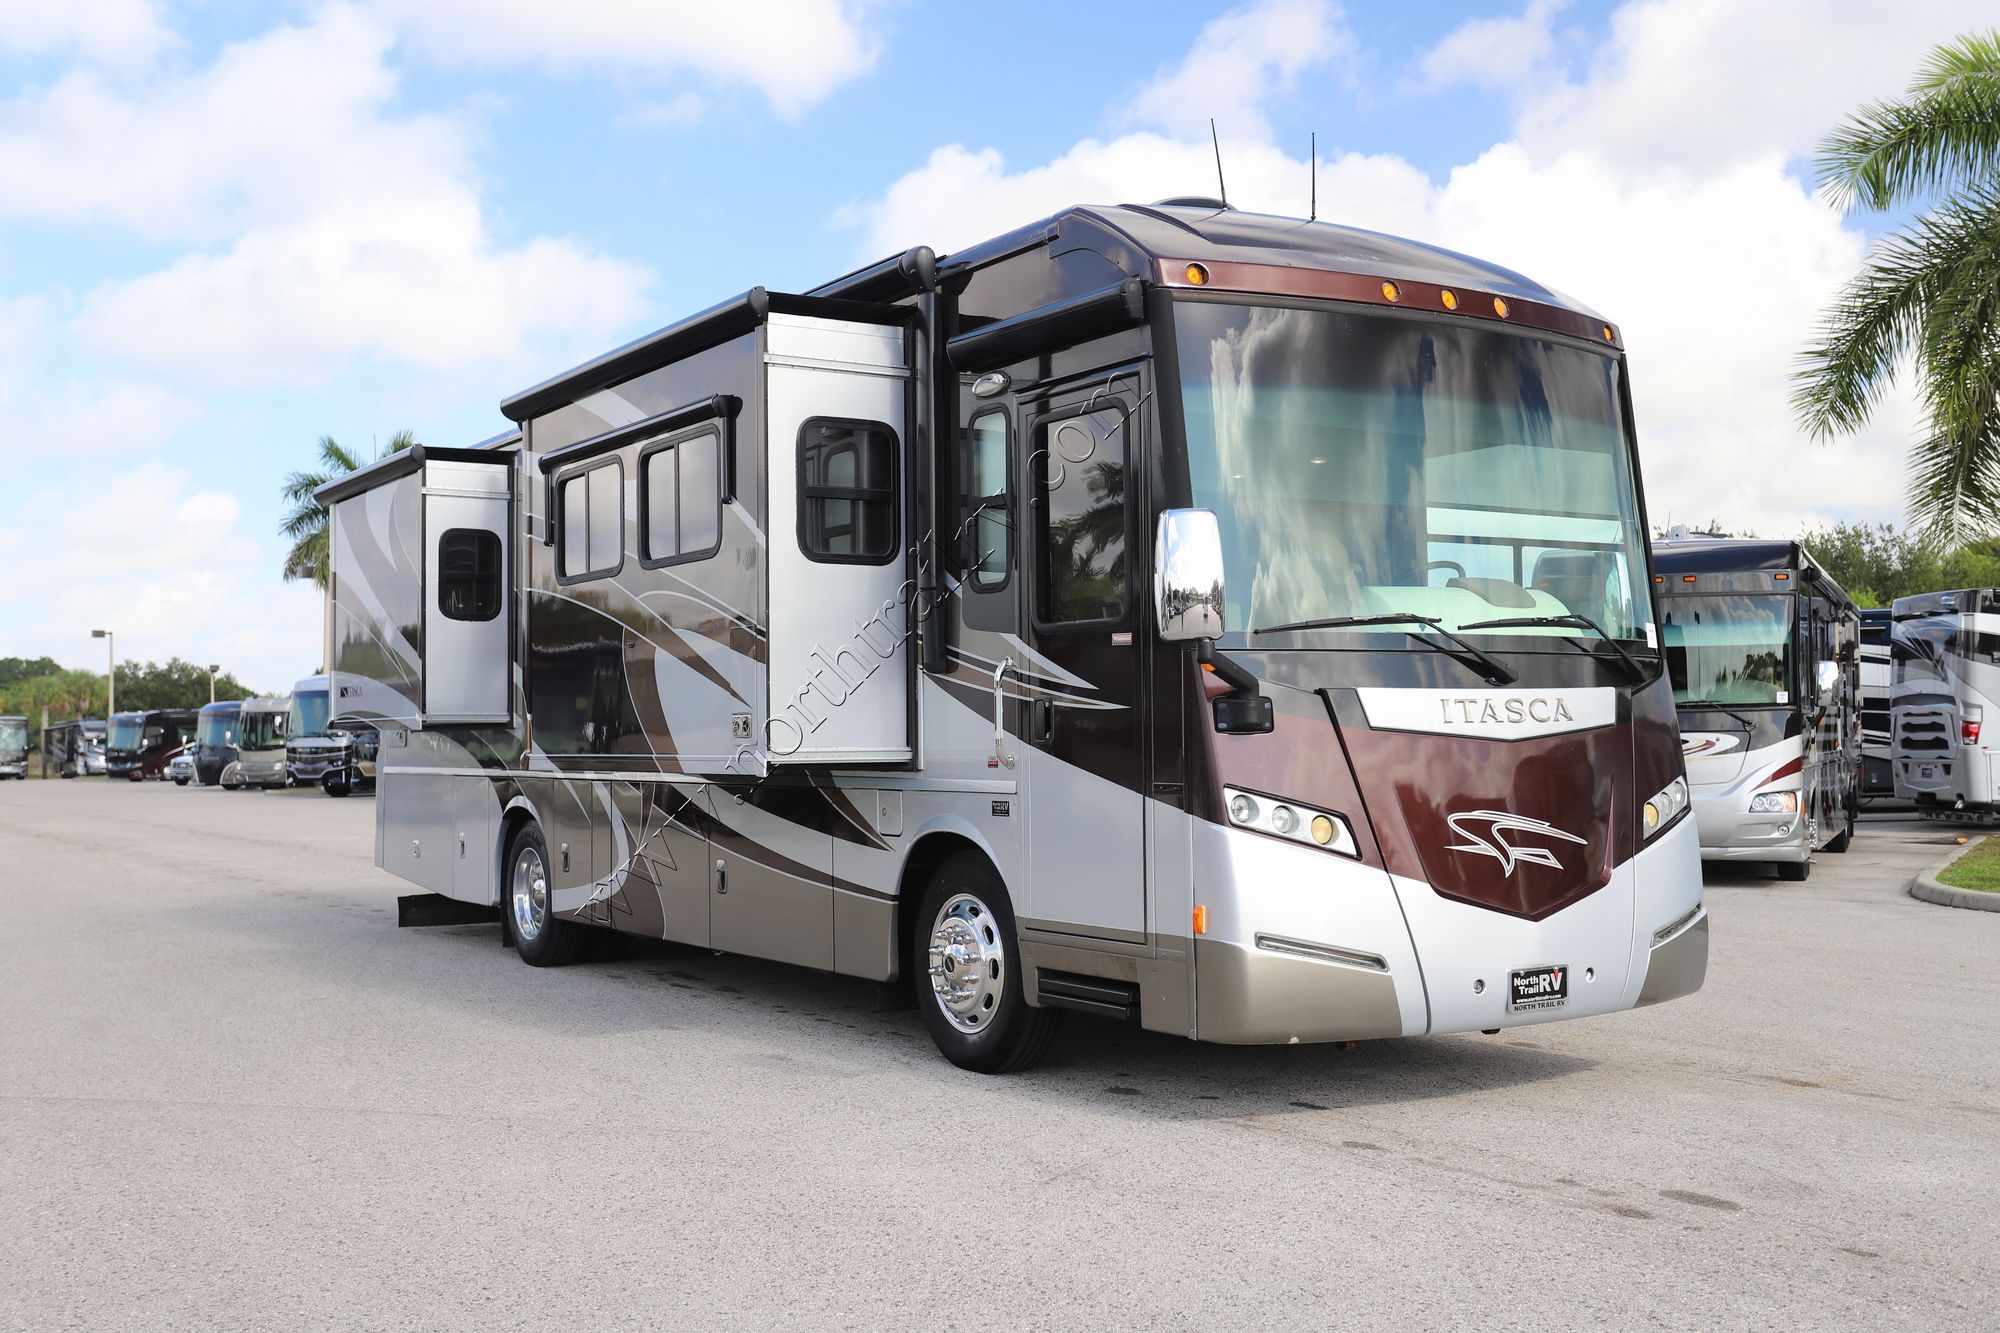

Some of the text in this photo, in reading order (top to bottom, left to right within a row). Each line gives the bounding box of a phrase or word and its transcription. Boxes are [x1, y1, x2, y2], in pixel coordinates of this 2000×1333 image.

[1440, 698, 1574, 724] ITASCA
[1513, 972, 1562, 992] North RV
[1519, 985, 1538, 994] Trail
[1514, 1003, 1536, 1011] NORTH
